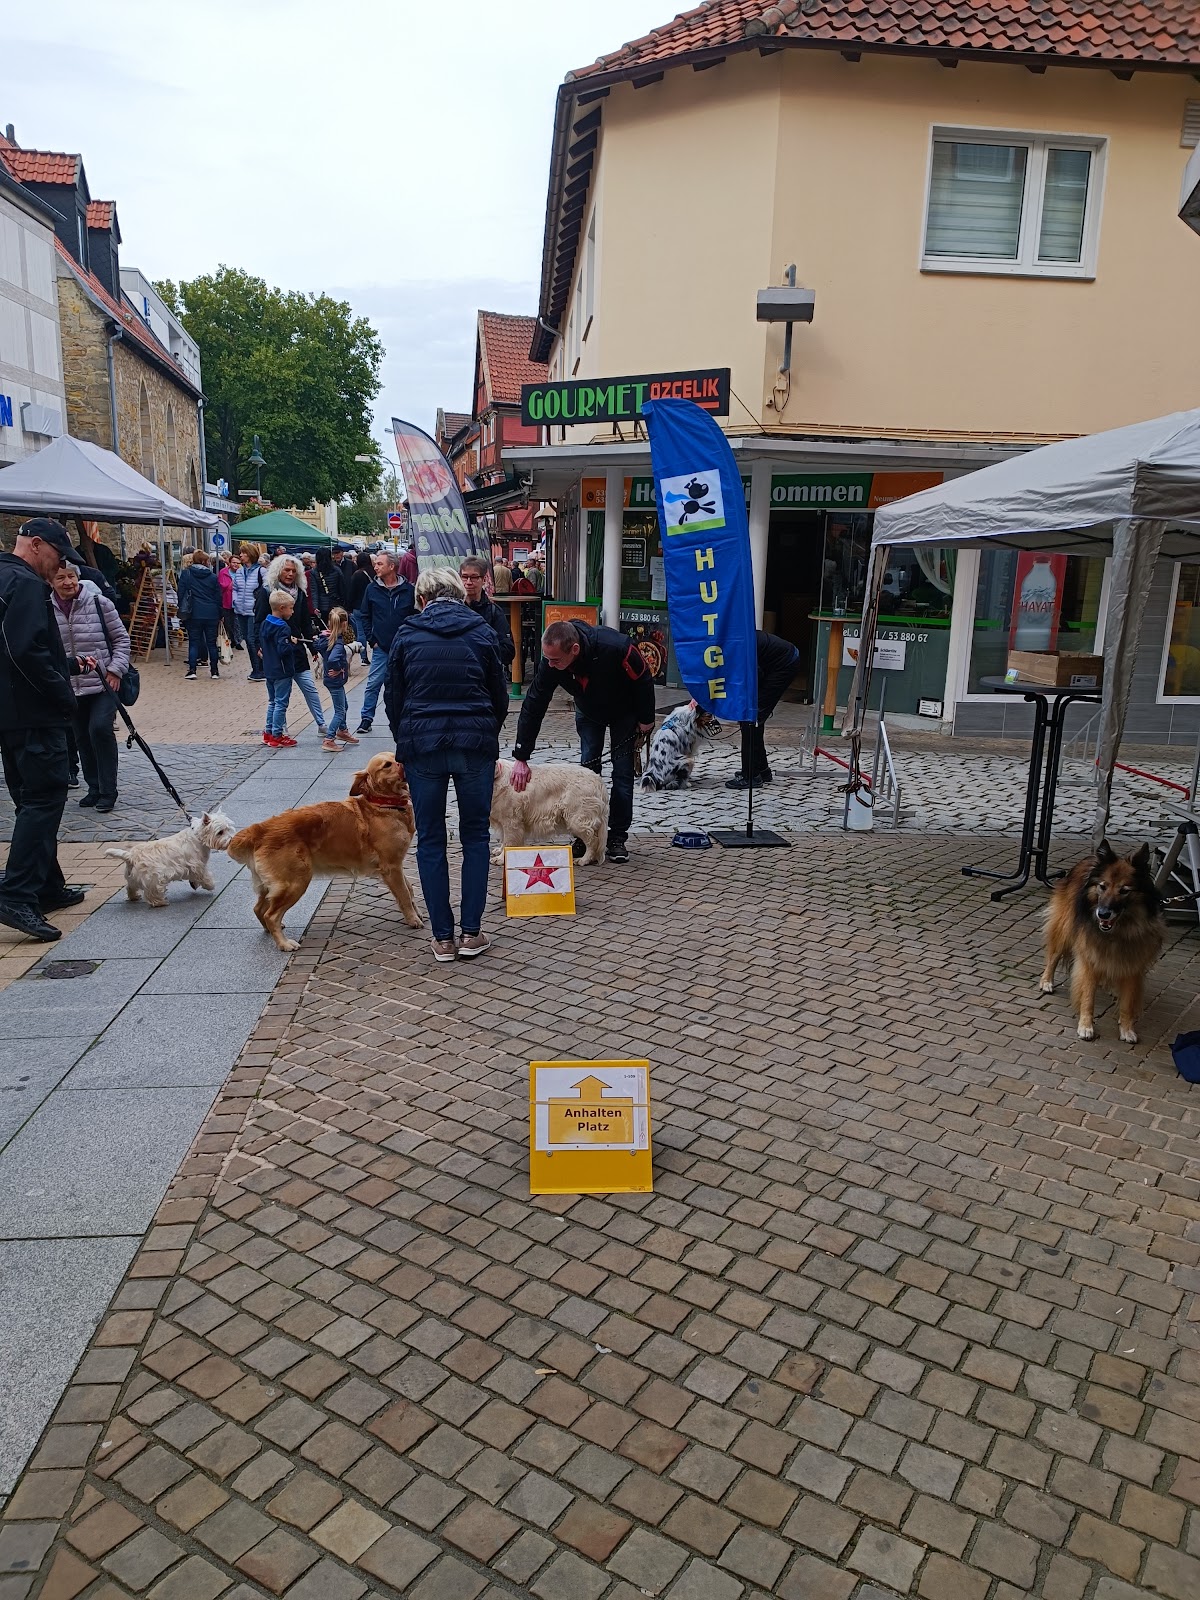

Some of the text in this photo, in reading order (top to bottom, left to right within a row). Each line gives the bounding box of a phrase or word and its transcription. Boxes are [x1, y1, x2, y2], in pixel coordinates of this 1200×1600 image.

[528, 382, 648, 420] GOURMET
[1021, 601, 1055, 613] HAYAT
[631, 612, 639, 621] 53
[640, 613, 651, 622] 880
[694, 547, 727, 700] HUTGE
[842, 627, 852, 637] el.
[888, 631, 898, 641] 53
[900, 632, 916, 642] 880
[917, 633, 929, 643] 67
[564, 1107, 622, 1118] Anhalten
[577, 1121, 610, 1132] Platz
